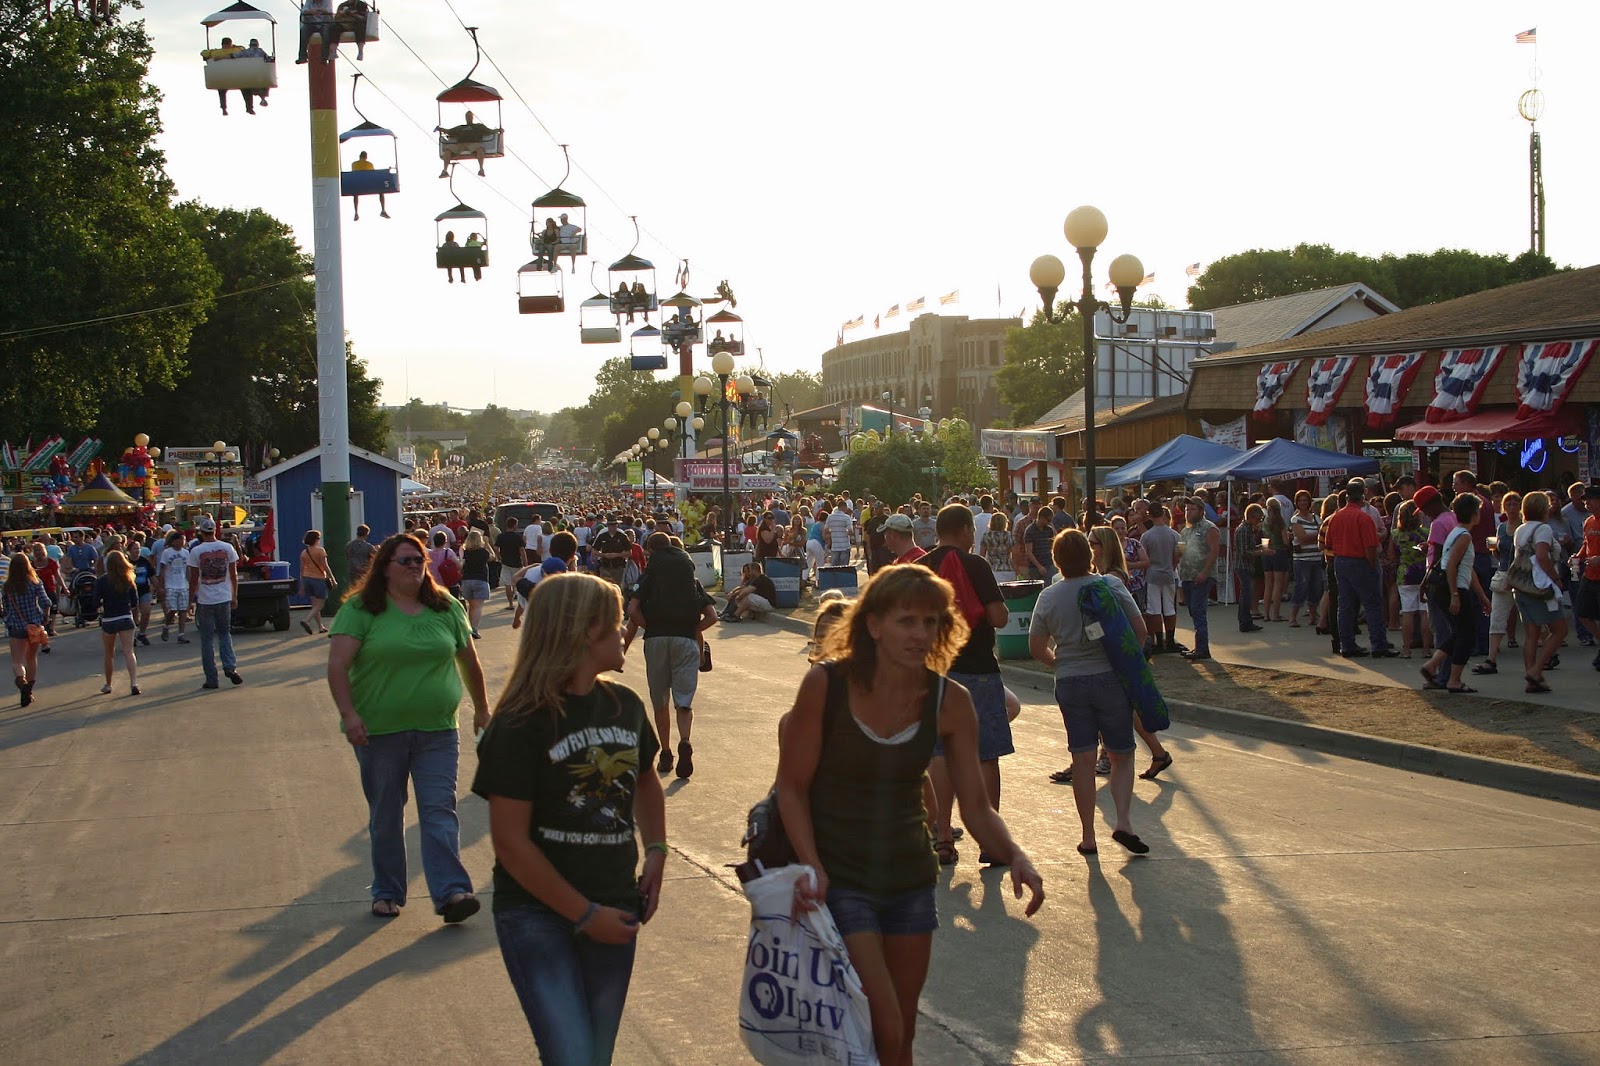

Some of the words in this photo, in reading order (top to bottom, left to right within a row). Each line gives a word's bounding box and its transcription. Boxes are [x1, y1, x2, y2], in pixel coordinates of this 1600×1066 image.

[384, 180, 390, 188] 5
[168, 451, 200, 459] PICKLE
[1265, 474, 1291, 483] TICTS
